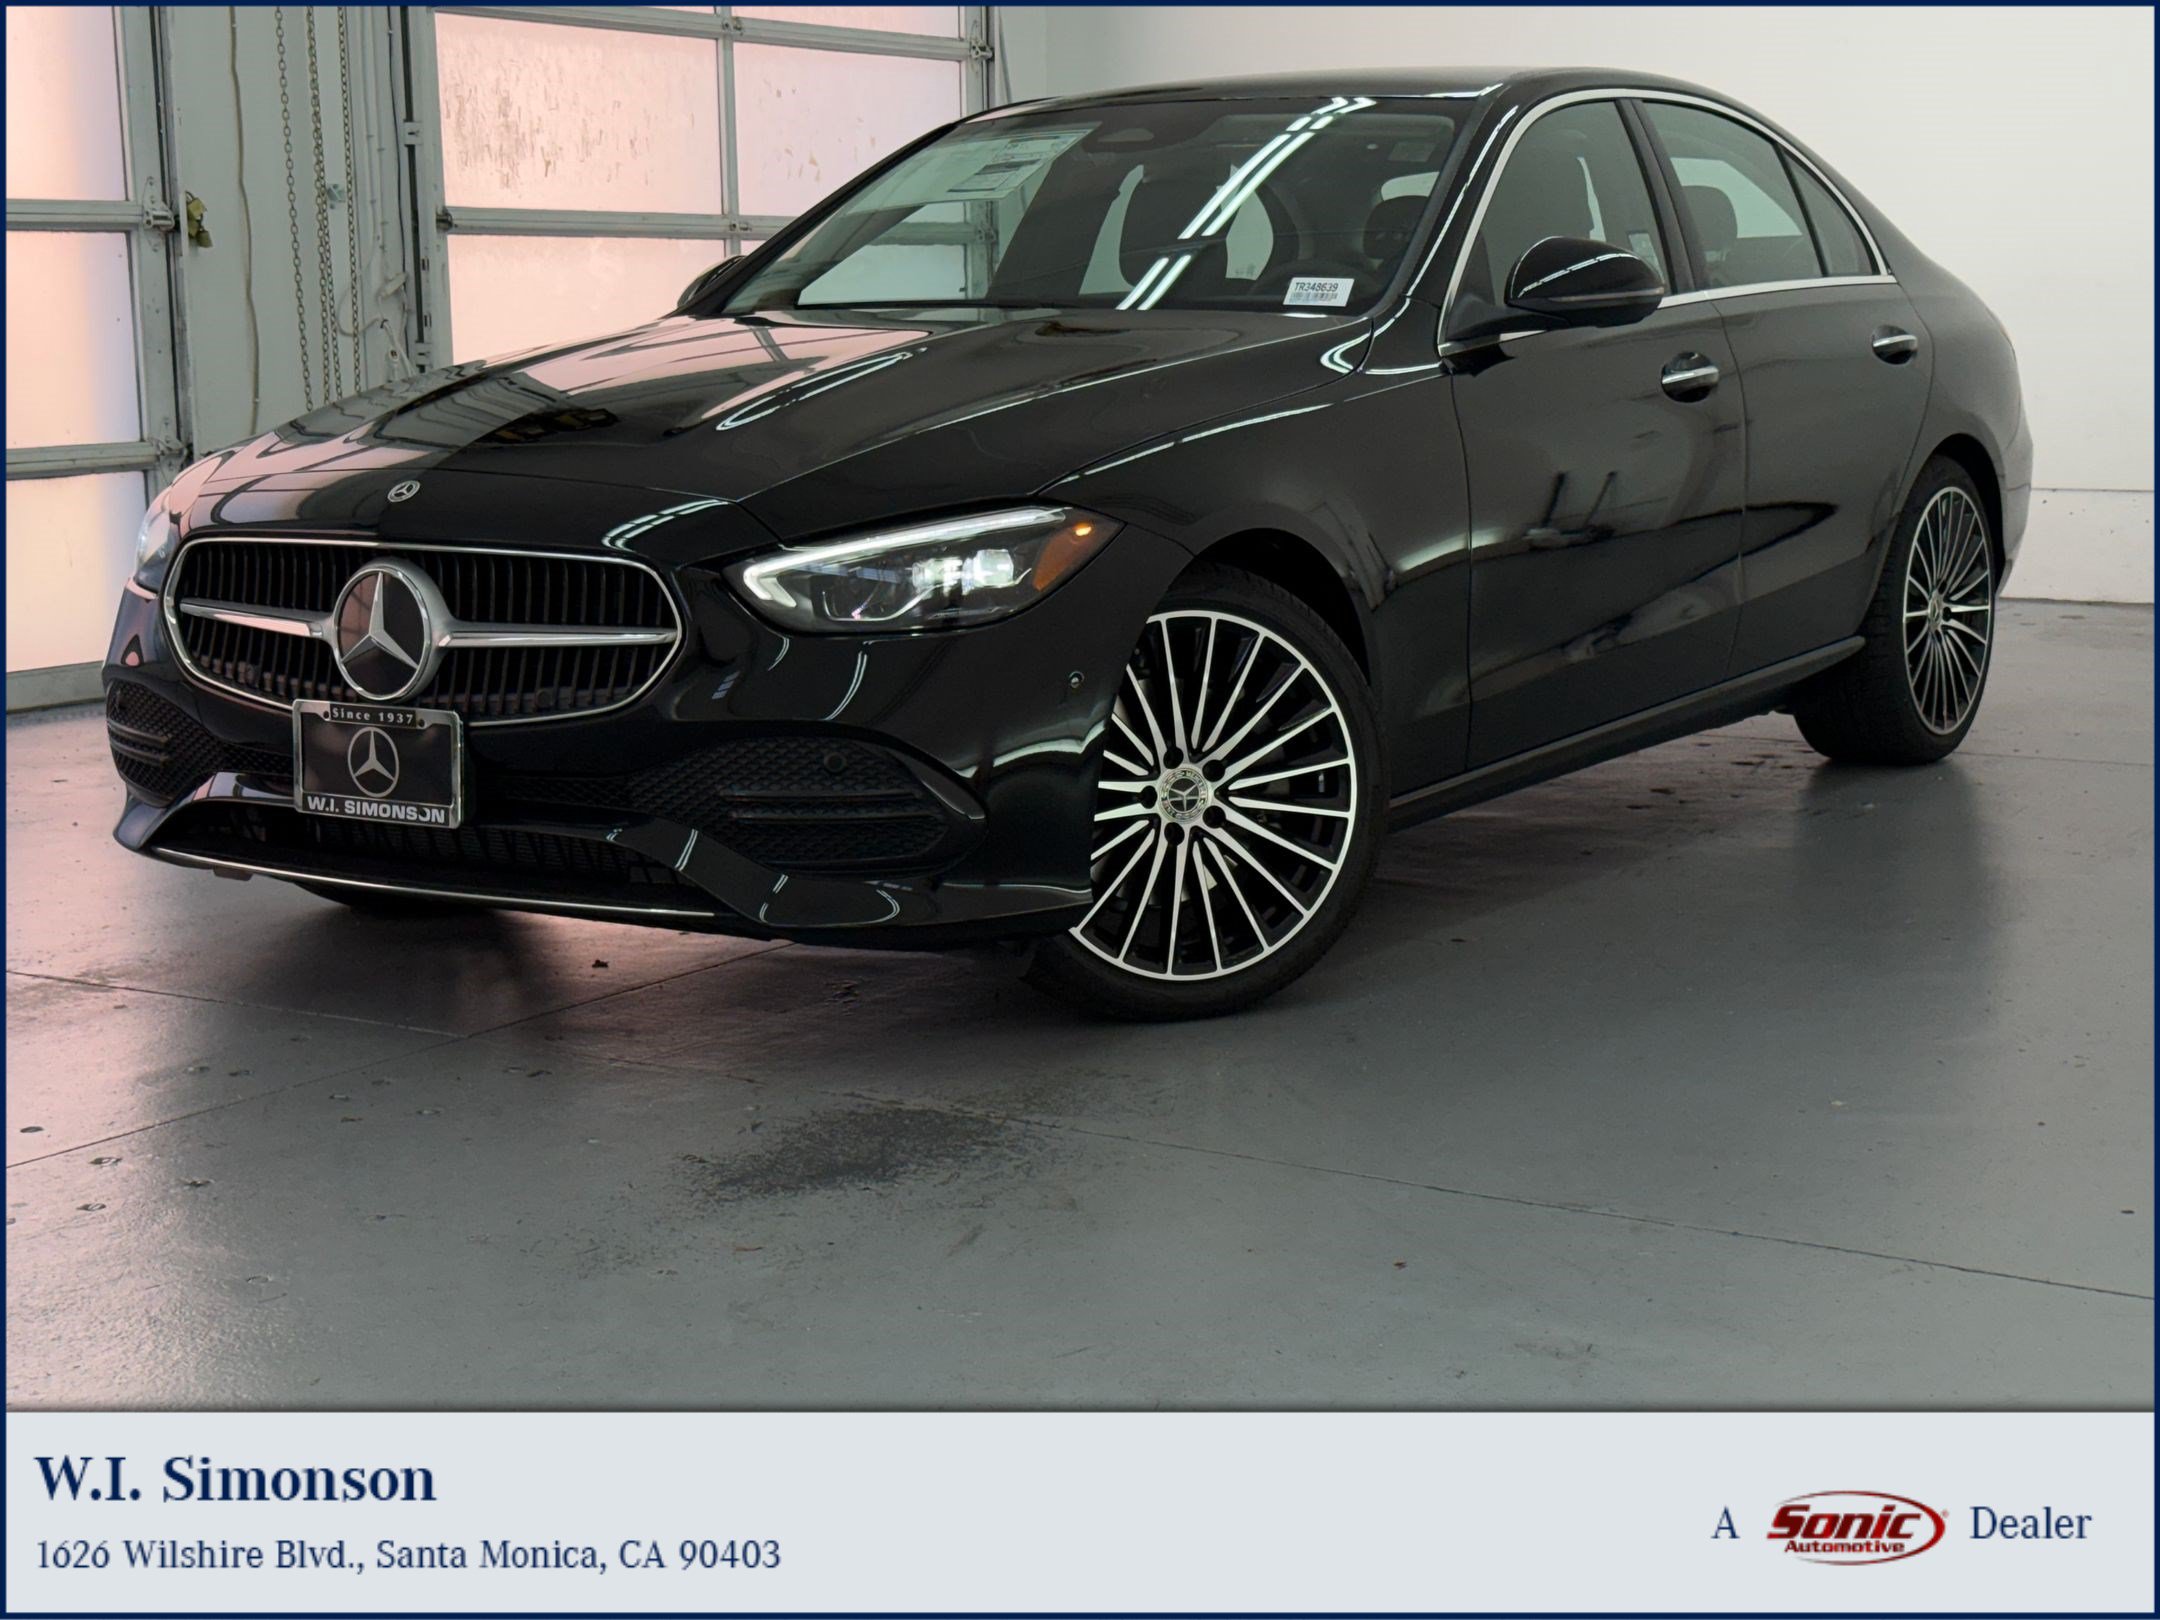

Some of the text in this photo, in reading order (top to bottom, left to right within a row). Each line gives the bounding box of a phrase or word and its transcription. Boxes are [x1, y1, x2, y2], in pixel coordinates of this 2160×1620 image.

[332, 707, 414, 725] Since 1937
[307, 795, 340, 813] W.I.
